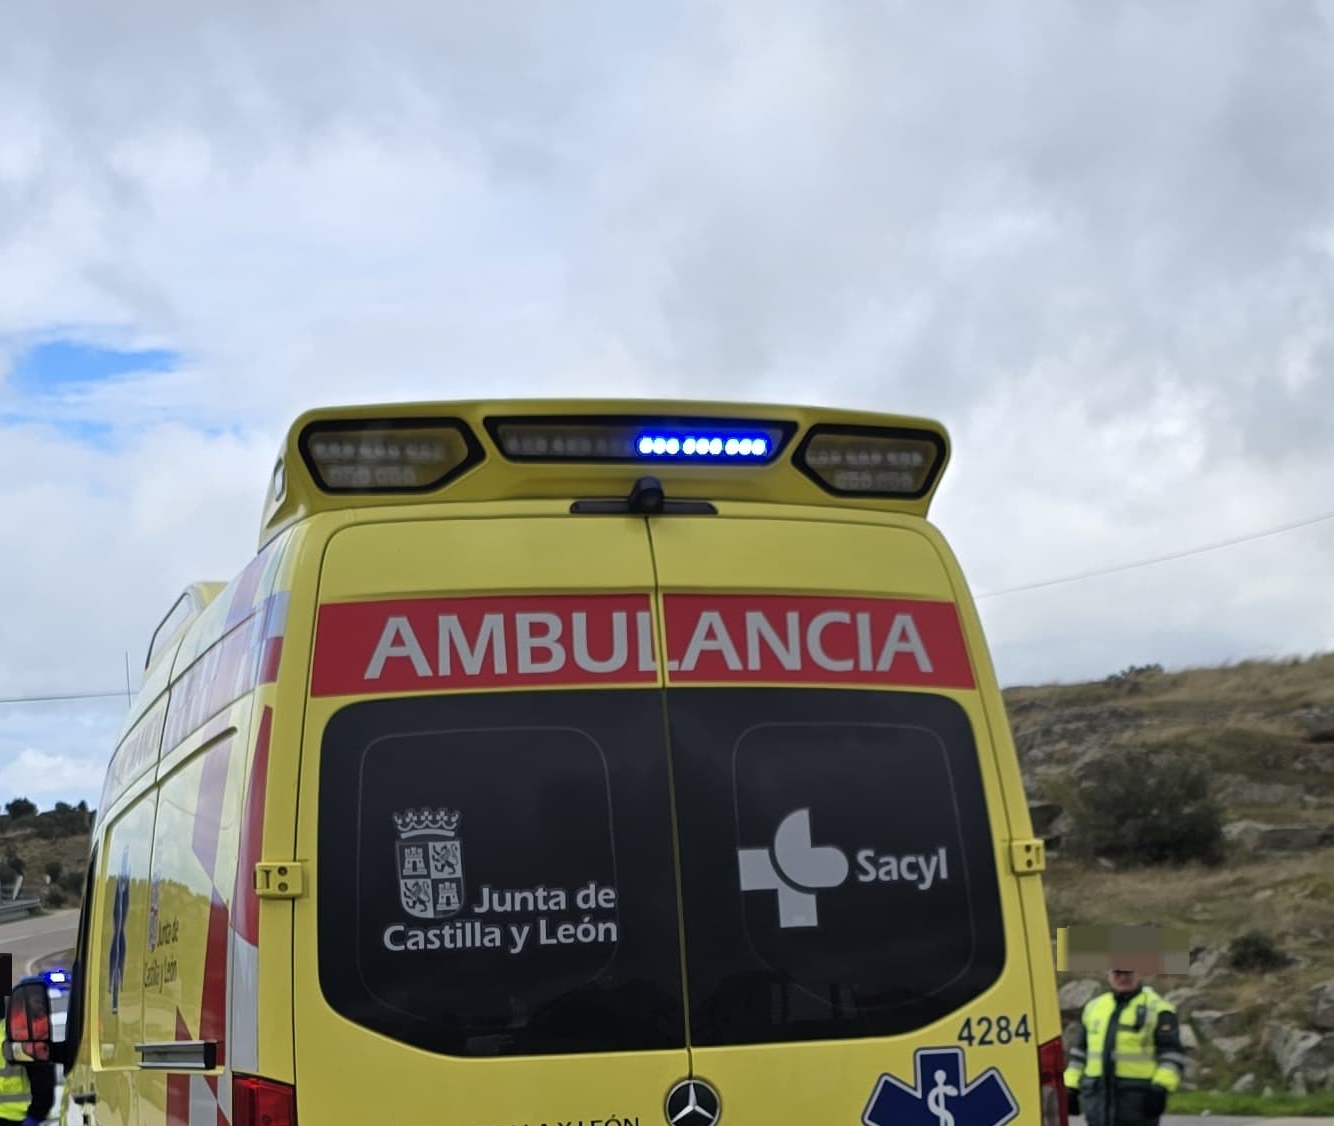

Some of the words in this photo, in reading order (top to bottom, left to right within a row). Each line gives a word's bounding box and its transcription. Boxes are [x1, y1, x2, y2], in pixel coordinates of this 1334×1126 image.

[364, 611, 933, 680] AMBULANCIA
[856, 847, 948, 890] Sacyl
[474, 886, 566, 913] Junta
[576, 883, 616, 910] de
[383, 921, 502, 951] Castilla
[510, 925, 530, 954] y
[539, 916, 618, 945] León
[957, 1014, 1031, 1046] 4284
